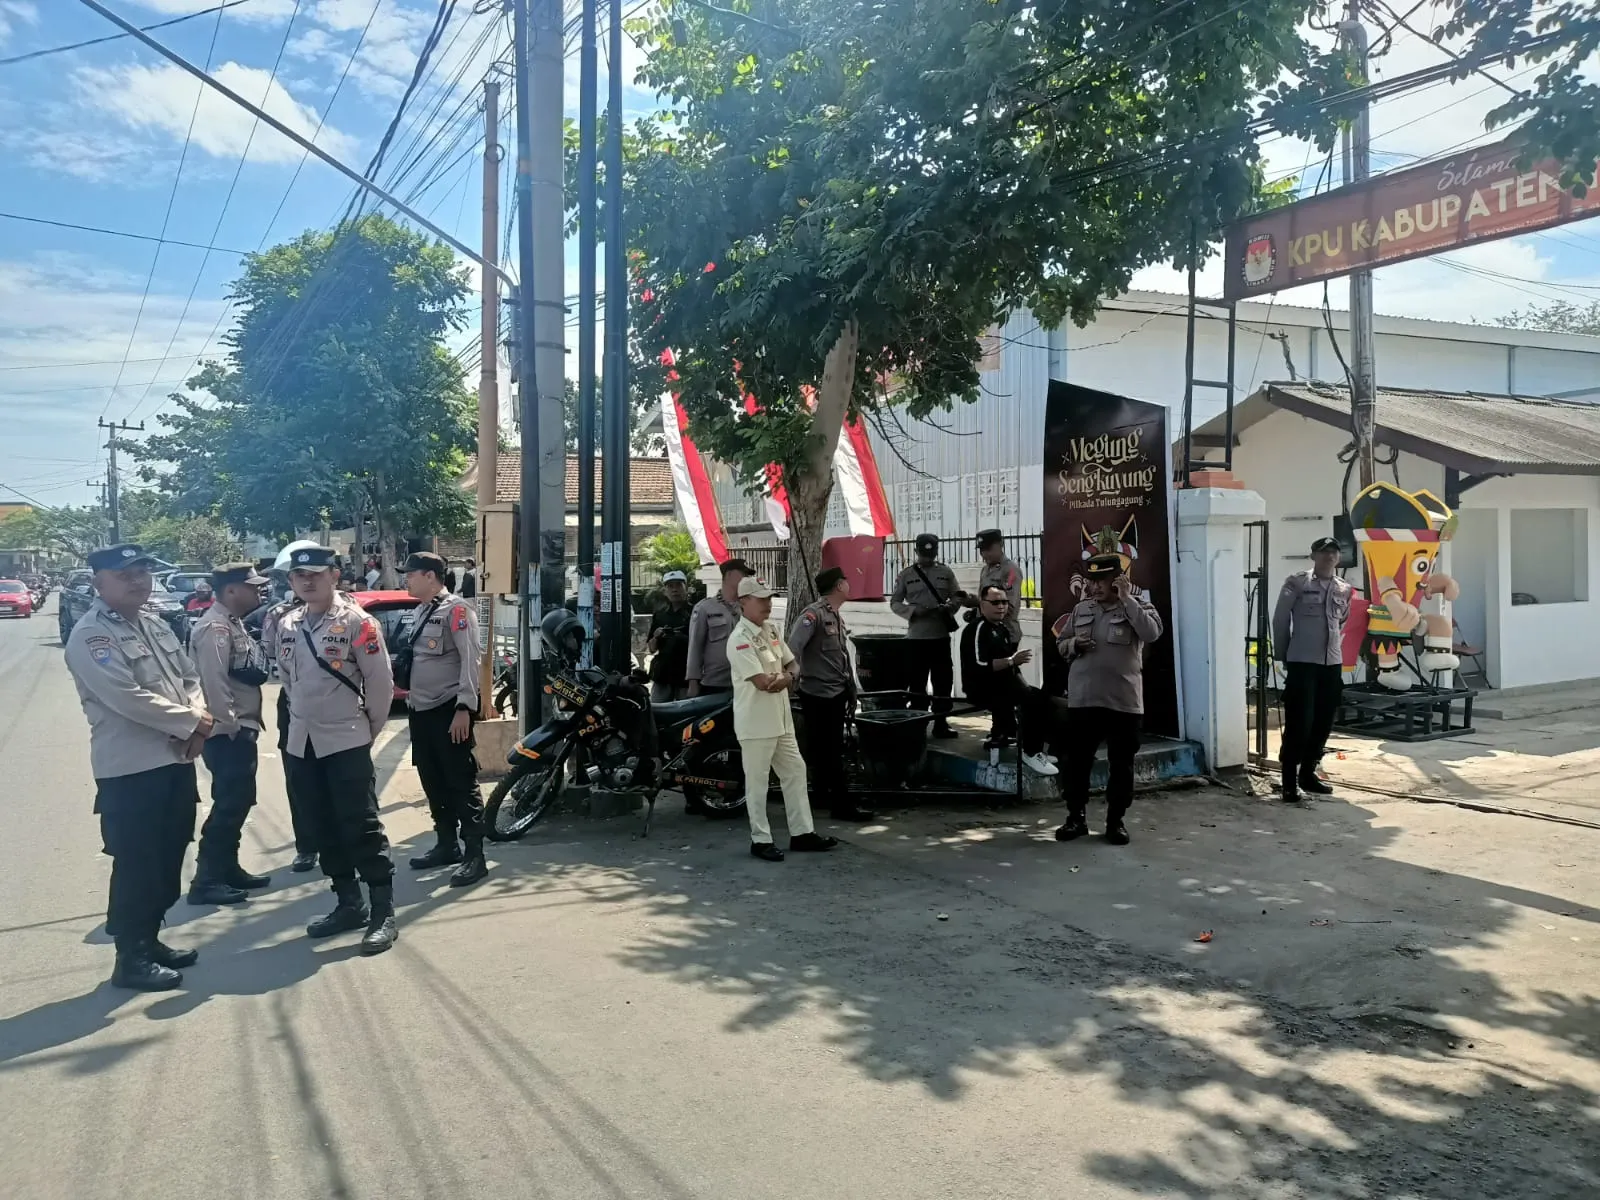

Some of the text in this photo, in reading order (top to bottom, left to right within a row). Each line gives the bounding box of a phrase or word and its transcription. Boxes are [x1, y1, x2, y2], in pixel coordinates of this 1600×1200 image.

[1437, 153, 1521, 191] Selama
[1288, 226, 1343, 268] KPU
[1351, 170, 1568, 251] KABUPATEN
[1069, 495, 1144, 509] Pilkada Tulungagung
[321, 636, 349, 645] POLRI
